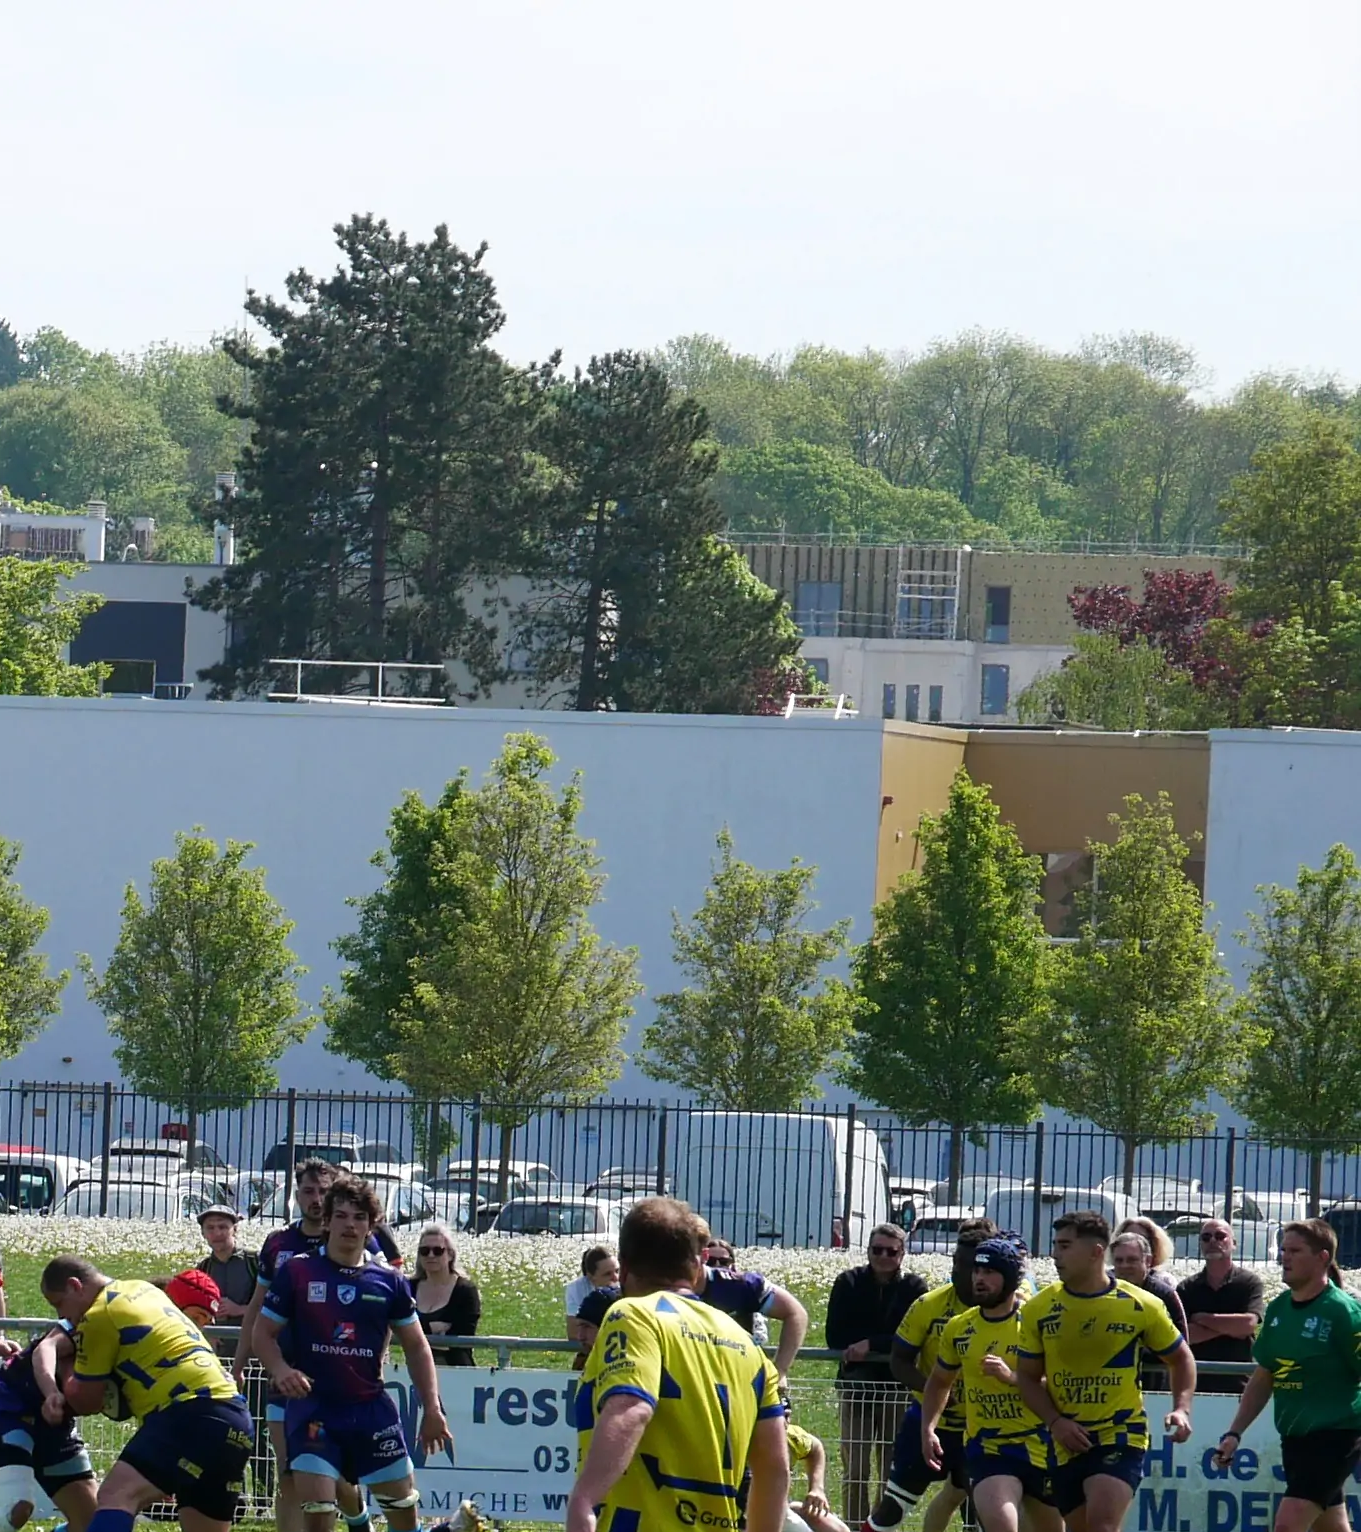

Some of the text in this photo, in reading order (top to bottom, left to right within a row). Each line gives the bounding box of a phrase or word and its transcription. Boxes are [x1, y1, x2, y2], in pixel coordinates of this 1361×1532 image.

[311, 1342, 374, 1358] BONGARD
[1052, 1371, 1123, 1392] Comptoir
[967, 1388, 1022, 1403] Compto
[1137, 1488, 1191, 1532] M.
